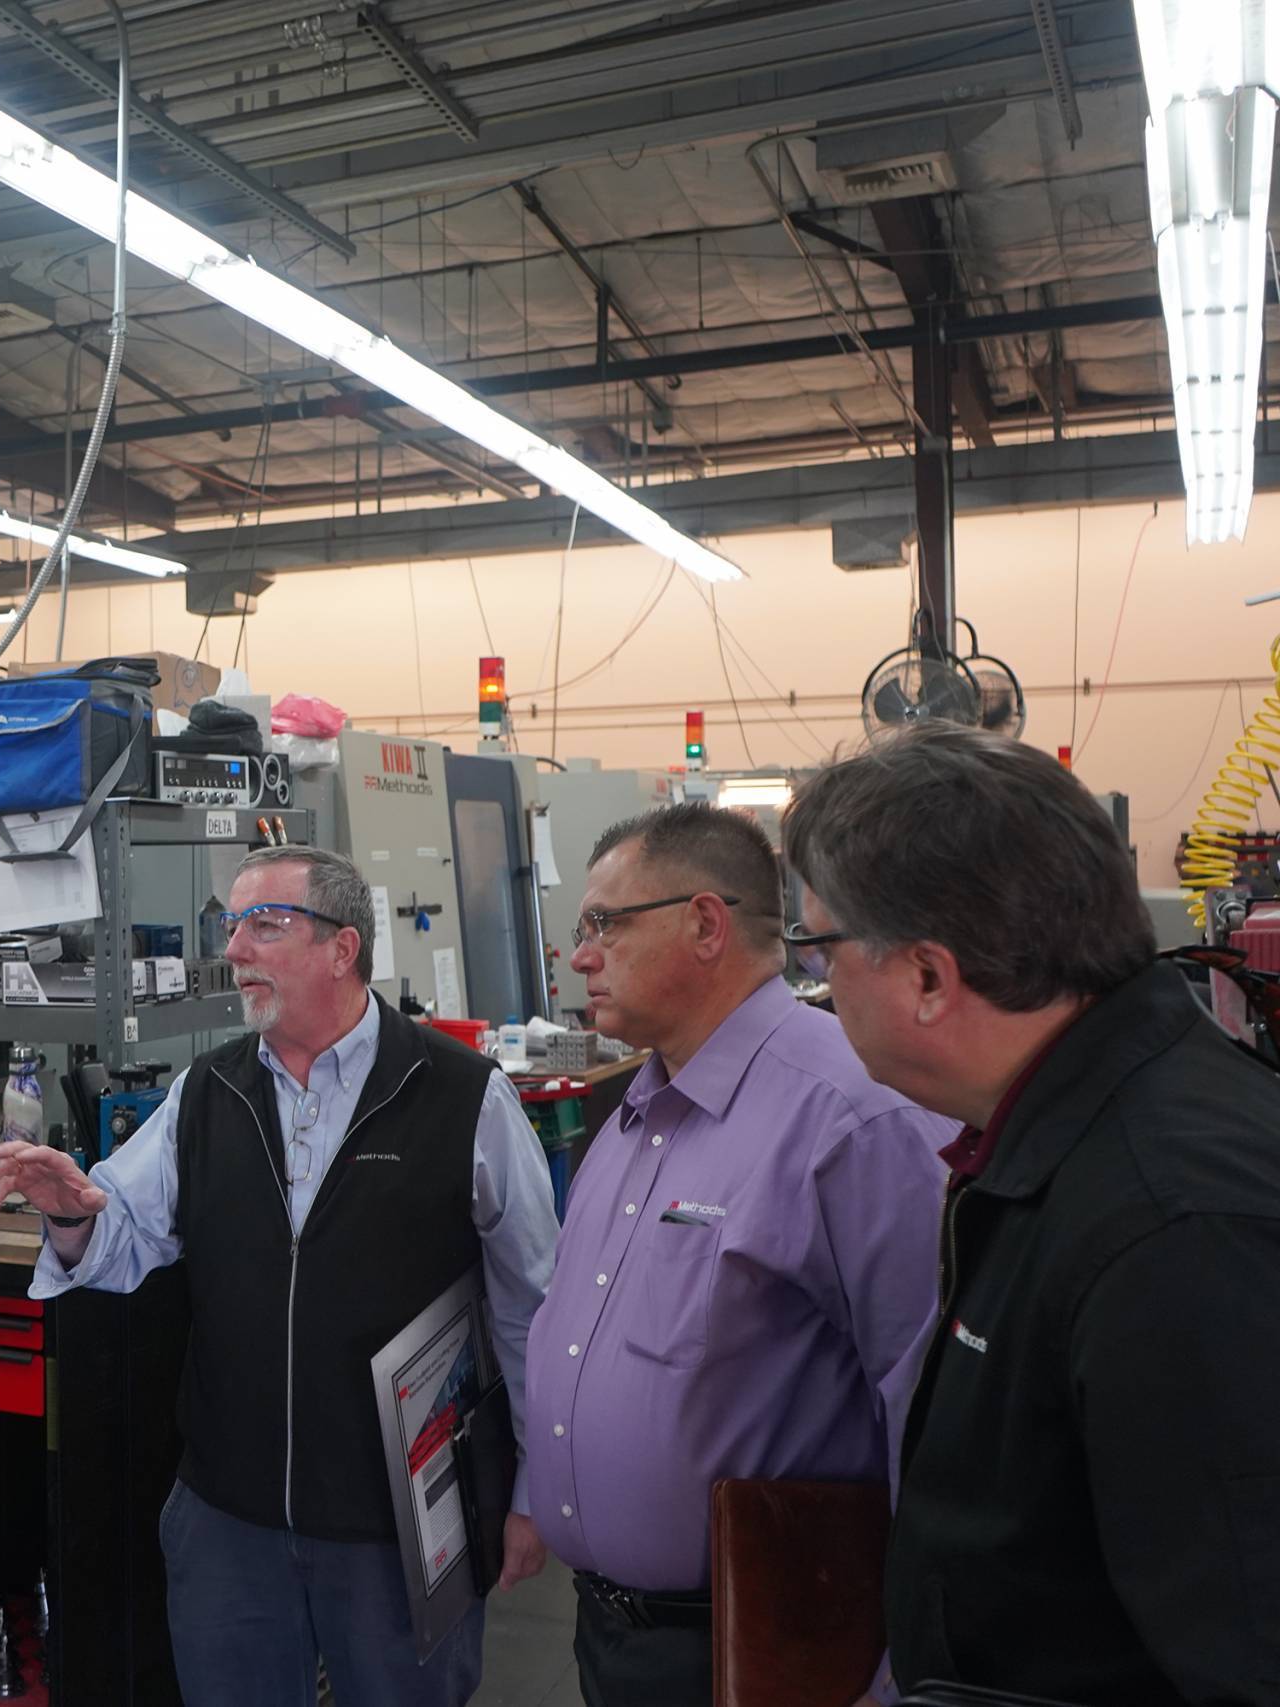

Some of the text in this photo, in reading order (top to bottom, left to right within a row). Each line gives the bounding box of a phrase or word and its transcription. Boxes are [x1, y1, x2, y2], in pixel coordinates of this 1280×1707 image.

[381, 742, 413, 776] KIWA
[377, 777, 433, 796] Methods
[208, 818, 232, 835] DELTA
[678, 1201, 727, 1217] Methods
